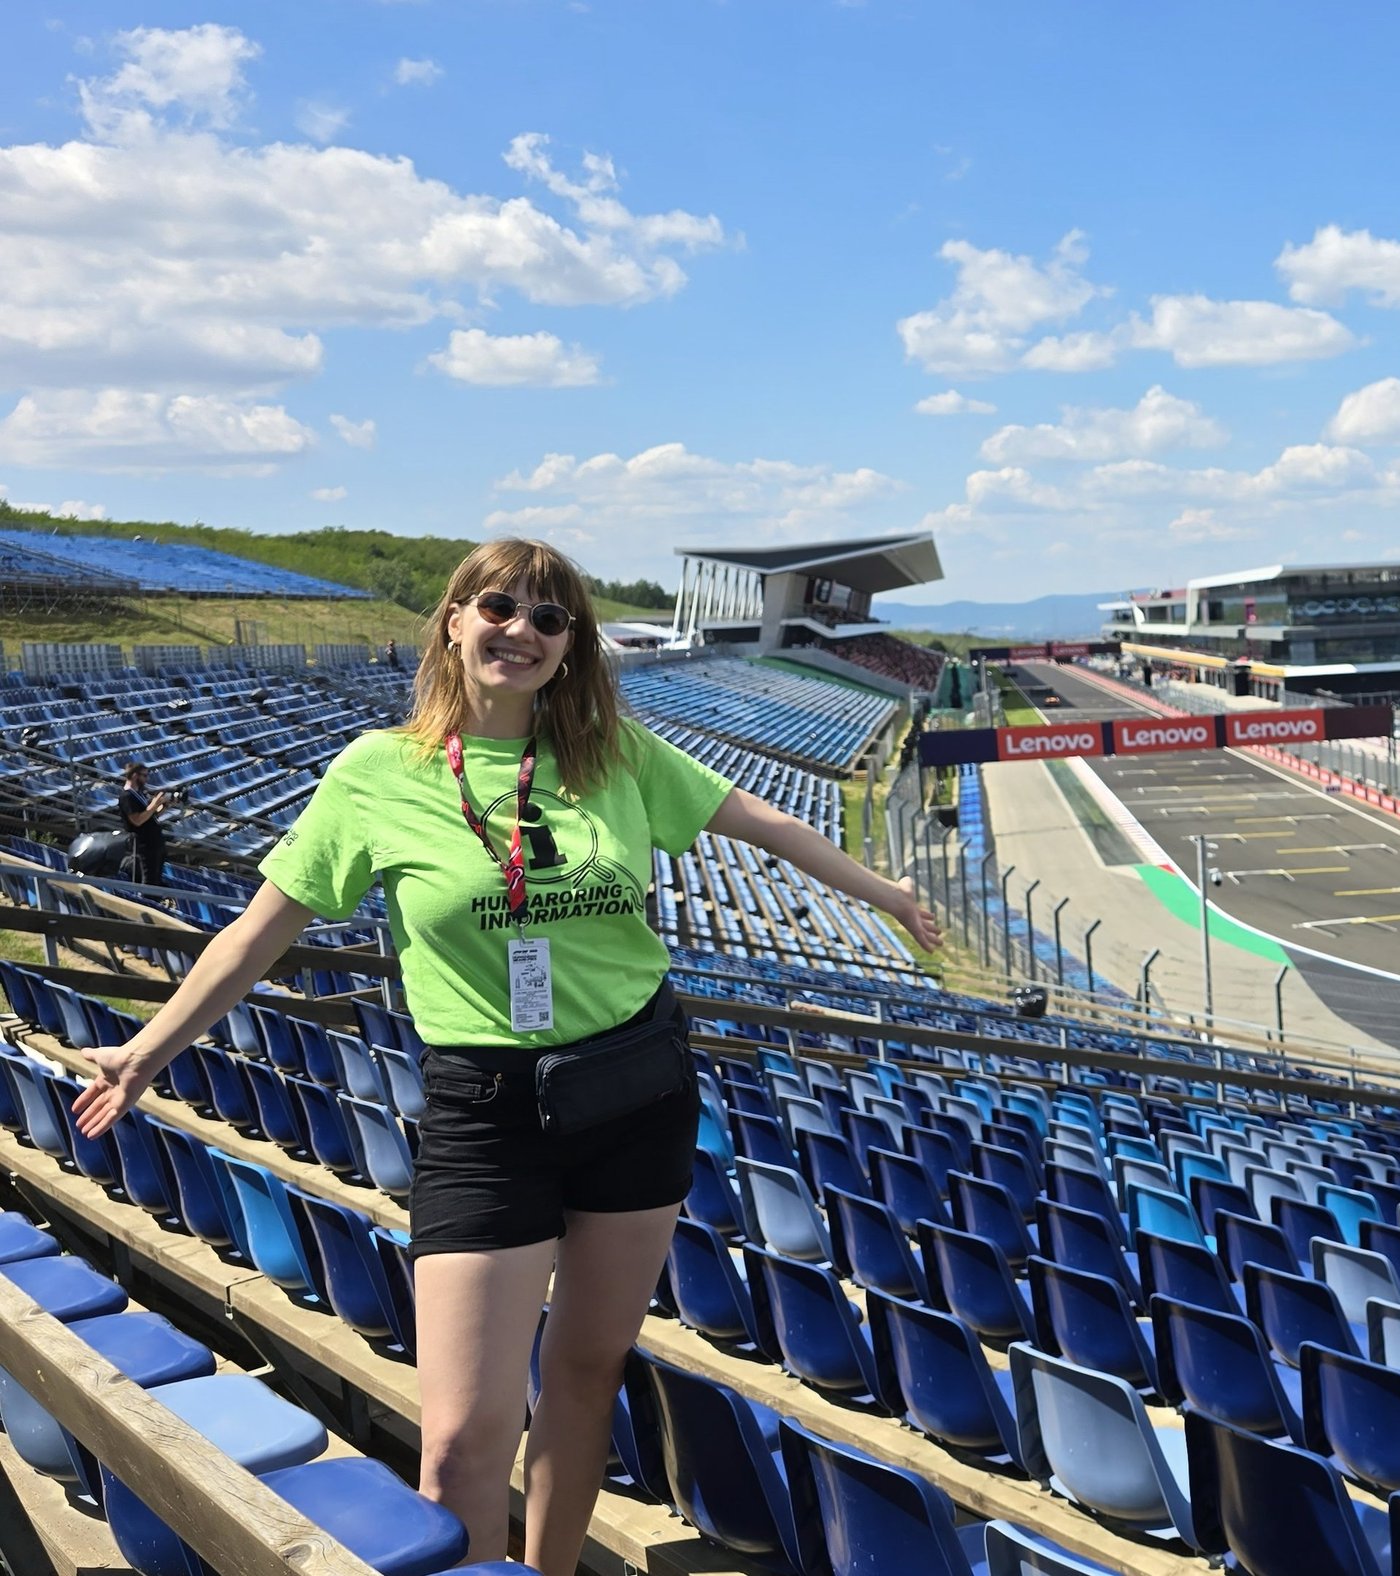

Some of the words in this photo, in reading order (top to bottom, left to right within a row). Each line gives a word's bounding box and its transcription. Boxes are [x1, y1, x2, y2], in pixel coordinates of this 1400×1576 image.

[1122, 726, 1208, 747] Lenovo
[1233, 719, 1317, 741] Lenovo
[1006, 732, 1094, 755] Lenovo
[472, 884, 623, 913] HUNARORING
